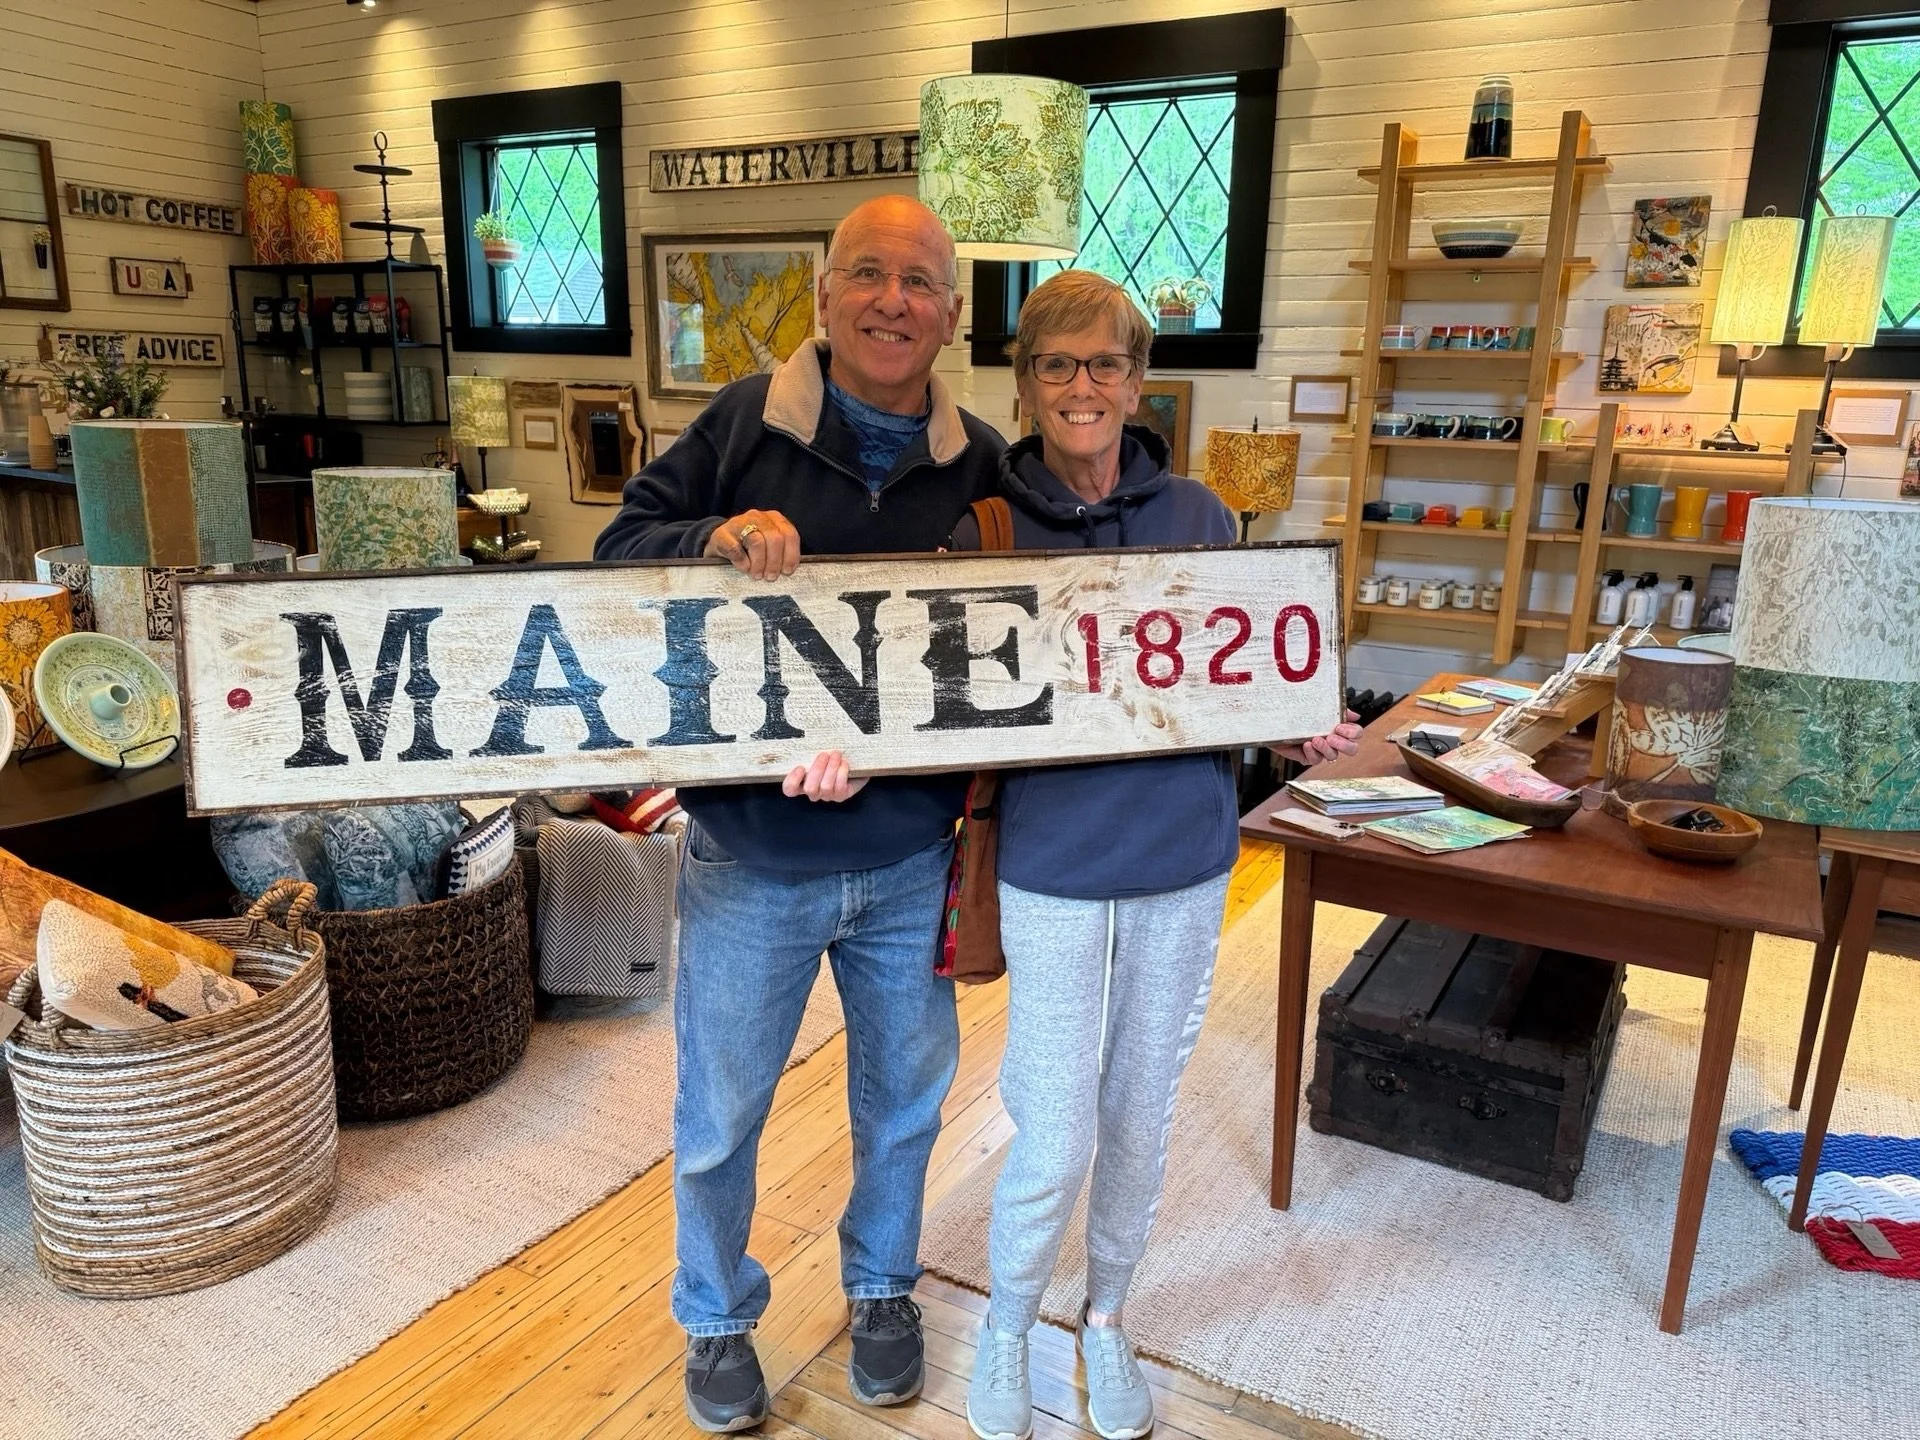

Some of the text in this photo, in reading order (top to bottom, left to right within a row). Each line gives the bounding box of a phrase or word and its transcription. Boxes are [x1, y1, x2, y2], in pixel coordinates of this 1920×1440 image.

[662, 135, 920, 187] WATERVILLE
[81, 189, 234, 231] HOT COFFEE
[125, 265, 177, 291] USA
[137, 337, 216, 361] ADVICE
[280, 585, 1321, 768] MAINE 1820
